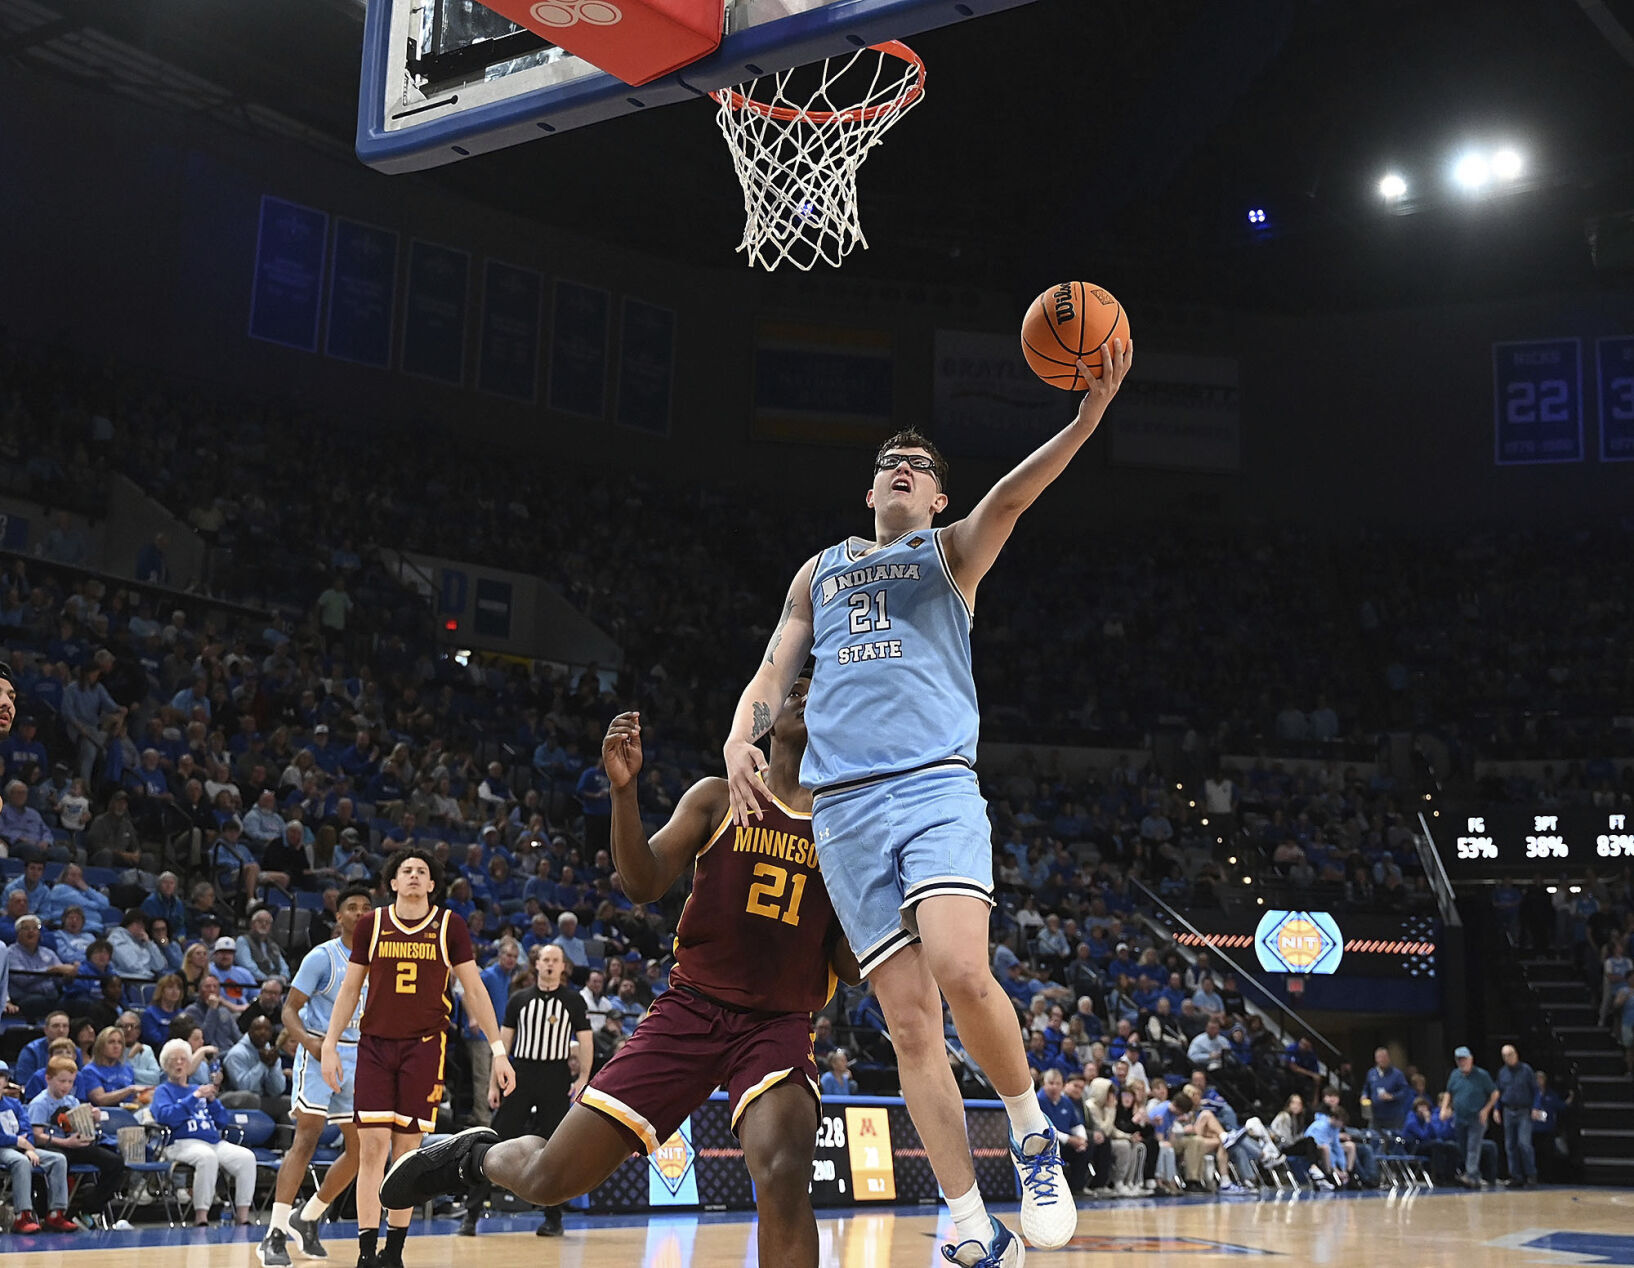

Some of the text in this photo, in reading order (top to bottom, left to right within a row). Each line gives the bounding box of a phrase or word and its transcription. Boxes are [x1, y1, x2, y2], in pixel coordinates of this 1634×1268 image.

[1506, 379, 1569, 424] 22
[848, 588, 892, 635] 21
[837, 639, 902, 666] STATE
[1467, 814, 1626, 833] FG 3PT FT
[733, 826, 821, 872] MINNESO
[1456, 836, 1499, 859] 53%
[1525, 835, 1569, 858] 38%
[746, 862, 807, 926] 21
[378, 941, 437, 961] MINNESOTA
[1281, 935, 1319, 950] NIT
[395, 961, 418, 994] 2
[816, 1116, 846, 1148] :28
[657, 1147, 684, 1161] NIT
